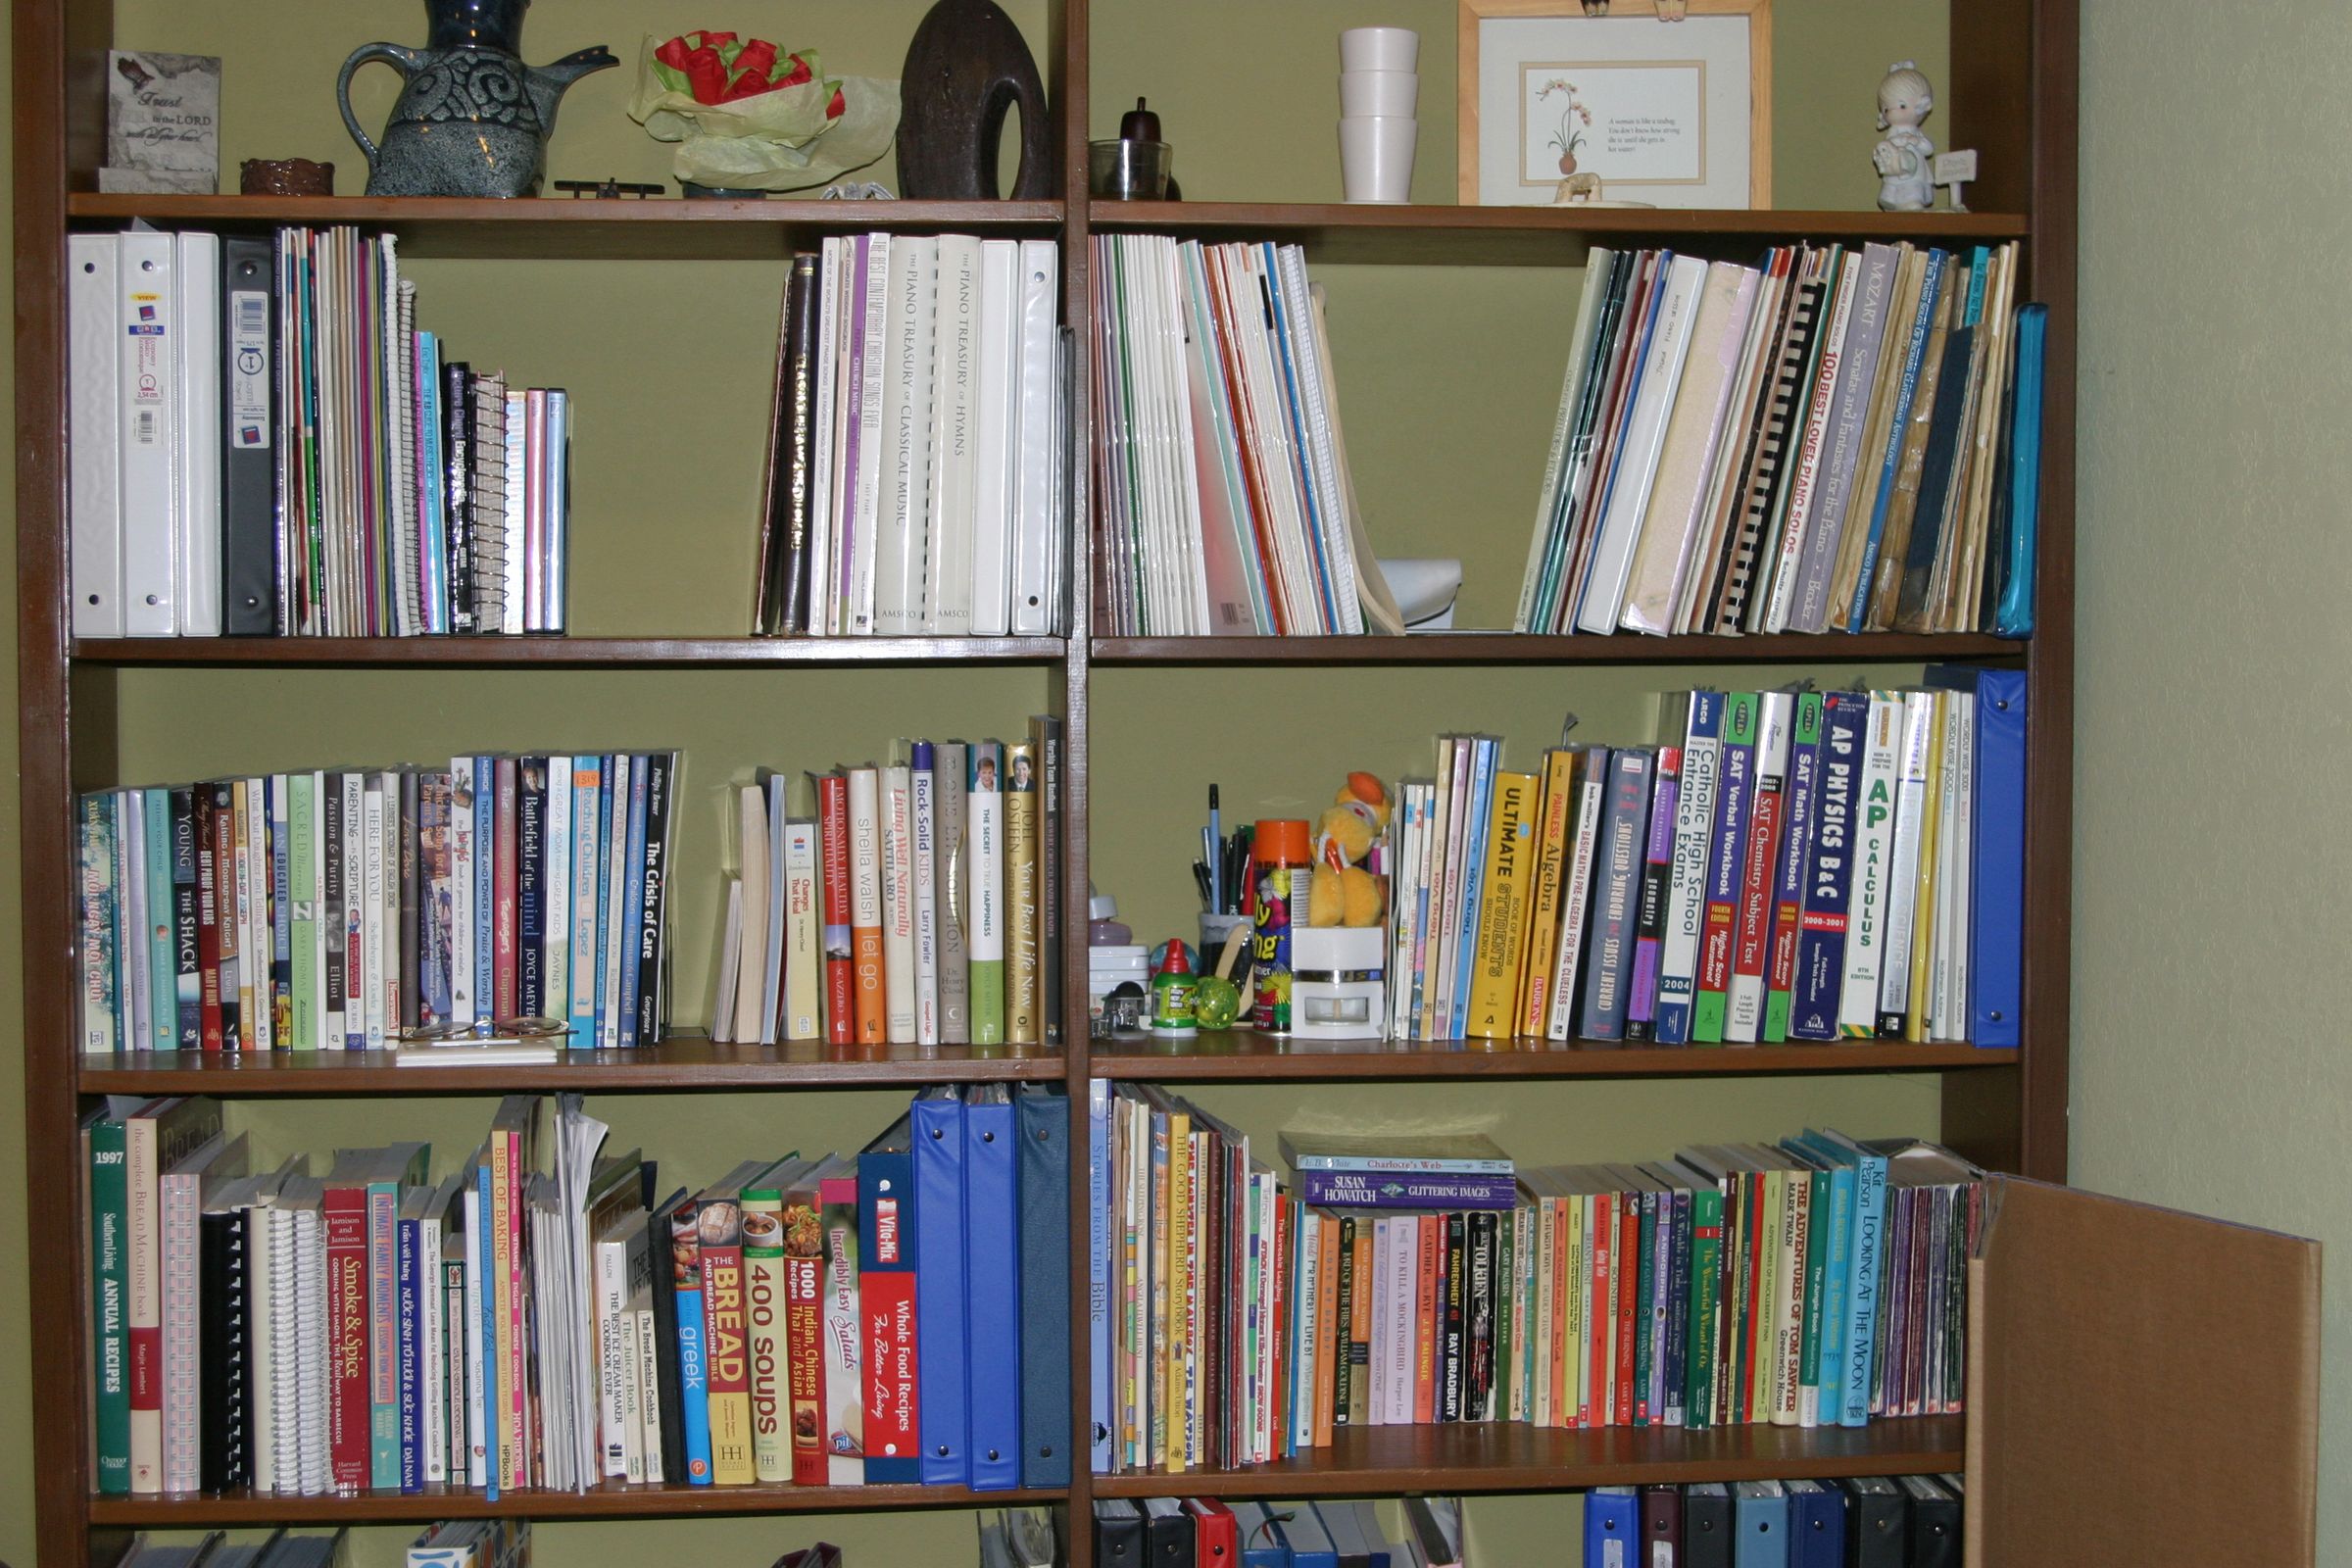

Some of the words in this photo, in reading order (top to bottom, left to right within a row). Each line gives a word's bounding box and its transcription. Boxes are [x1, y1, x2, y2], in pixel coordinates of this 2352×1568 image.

[176, 116, 212, 126] LORD
[906, 270, 917, 314] PIANO
[959, 270, 970, 314] PIANO
[1861, 262, 1886, 327] MOZART
[903, 319, 915, 387] TREASURY
[957, 319, 968, 387] TREASURY
[1821, 351, 1839, 381] 100
[1845, 347, 1868, 398] Sonatas
[1815, 382, 1831, 416] BEST
[955, 406, 966, 456] HYMNS
[1805, 419, 1825, 463] LOVED
[1793, 466, 1813, 507] PIANO
[1785, 510, 1803, 554] SOLOS
[1815, 517, 1836, 553] Piano
[1832, 725, 1853, 754] AP
[1730, 750, 1744, 779] SAT
[1797, 754, 1810, 783] SAT
[1679, 749, 1699, 826] Entrance
[1692, 750, 1715, 824] Catholic
[1726, 786, 1740, 826] Verbal
[1793, 789, 1807, 822] Math
[1822, 763, 1849, 848] PHYSICS
[296, 791, 308, 854] SACRED
[328, 797, 338, 839] Passion
[348, 782, 358, 837] PARENTING
[369, 808, 379, 844] HERE
[524, 796, 538, 858] Battlefield
[835, 786, 847, 863] EMOTIONALLY
[894, 788, 908, 832] Living
[916, 778, 930, 851] Rock-Solid
[1549, 793, 1562, 839] PAINLESS
[1757, 797, 1771, 822] SAT
[647, 842, 661, 865] The
[858, 818, 875, 866] sheila
[895, 835, 907, 865] Well
[1496, 788, 1521, 877] ULTIMATE
[1687, 830, 1706, 872] High
[277, 854, 287, 902] EDUCATED
[327, 859, 339, 896] Purity
[369, 846, 379, 872] FOR
[582, 843, 593, 896] Children
[917, 854, 930, 886] KIDS
[1540, 843, 1561, 912] Algebra
[1673, 833, 1692, 888] Exams
[1717, 830, 1736, 895] Workbook
[1749, 827, 1769, 888] Chemistry
[1787, 826, 1803, 891] Workbook
[202, 892, 213, 907] YOUR
[348, 855, 359, 906] SCRIPTURE
[370, 875, 380, 901] YOU
[645, 869, 660, 906] Crisis
[801, 878, 809, 911] Changes
[838, 866, 848, 916] HEALTHY
[860, 872, 875, 920] walsh
[203, 909, 214, 925] KIDS
[524, 893, 540, 936] mind
[645, 911, 658, 925] of
[792, 898, 801, 914] Heal
[895, 869, 909, 937] Naturally
[920, 909, 932, 933] Larry
[983, 890, 992, 937] HAPPINESS
[1020, 902, 1035, 936] Best
[1683, 876, 1702, 936] School
[1744, 893, 1762, 935] Subject
[180, 916, 195, 971] SHACK
[277, 906, 287, 953] CHOICE
[579, 918, 591, 956] Lopez
[643, 931, 656, 958] Care
[862, 935, 878, 959] let
[922, 936, 932, 964] Fowler
[1481, 934, 1490, 959] KNOW
[1489, 883, 1512, 977] STUDENTS
[525, 949, 536, 980] JOYCE
[1019, 939, 1035, 970] Life
[1743, 940, 1758, 963] Test
[205, 969, 217, 987] MARY
[206, 989, 218, 1006] HUNT
[330, 965, 340, 999] Elliot
[860, 963, 877, 990] go
[350, 1002, 359, 1029] DURBIN
[388, 982, 398, 1029] Newsweek
[96, 1151, 124, 1164] 1997
[495, 1148, 507, 1182] BEST
[1176, 1134, 1186, 1160] THE
[1420, 1160, 1442, 1169] Web
[496, 1187, 507, 1206] OF
[1176, 1165, 1186, 1203] GOOD
[1325, 1189, 1376, 1201] HOWATCH
[1408, 1186, 1457, 1197] GLITTERING
[1459, 1188, 1491, 1198] IMAGES
[1335, 1176, 1365, 1189] SUSAN
[1787, 1183, 1795, 1211] MARK
[1797, 1181, 1808, 1212] THE
[1860, 1161, 1873, 1207] Pearson
[1872, 1171, 1884, 1187] Kit
[496, 1210, 509, 1260] BAKING
[1175, 1207, 1186, 1273] SHEPHERD
[1786, 1214, 1794, 1247] TWAIN
[1859, 1215, 1878, 1280] LOOKING
[831, 1230, 849, 1285] Incredibly
[1450, 1249, 1460, 1306] FAHRENHEIT
[1793, 1214, 1806, 1299] ADVENTURES
[344, 1256, 362, 1313] Smoke
[752, 1264, 772, 1326] 400
[789, 1260, 801, 1299] Recipes
[802, 1261, 814, 1298] 1000
[838, 1288, 851, 1311] Easy
[105, 1278, 119, 1332] ANNUAL
[792, 1305, 804, 1332] Thai
[896, 1300, 909, 1343] Whole
[1092, 1282, 1106, 1322] Bible
[1172, 1278, 1186, 1336] Storybook
[1791, 1303, 1800, 1321] OF
[715, 1268, 743, 1382] BREAD
[793, 1336, 803, 1356] and
[804, 1305, 816, 1348] Indian,
[834, 1315, 857, 1370] Salads
[1396, 1302, 1406, 1371] MOCKINGBIRD
[1448, 1333, 1457, 1355] RAY
[1789, 1325, 1798, 1355] TOM
[106, 1338, 121, 1393] RECIPES
[342, 1335, 362, 1378] Spice
[679, 1327, 704, 1390] greek
[874, 1338, 887, 1374] Better
[898, 1347, 910, 1379] Food
[1340, 1331, 1348, 1365] WILLIAM
[1851, 1339, 1868, 1390] MOON
[755, 1337, 777, 1435] soups
[794, 1361, 805, 1396] Asian
[806, 1349, 818, 1396] Chinese
[1446, 1358, 1457, 1416] BRADBURY
[1787, 1358, 1797, 1412] SAWYER
[625, 1384, 636, 1414] Book
[871, 1380, 889, 1419] Living
[898, 1383, 911, 1431] Recipes
